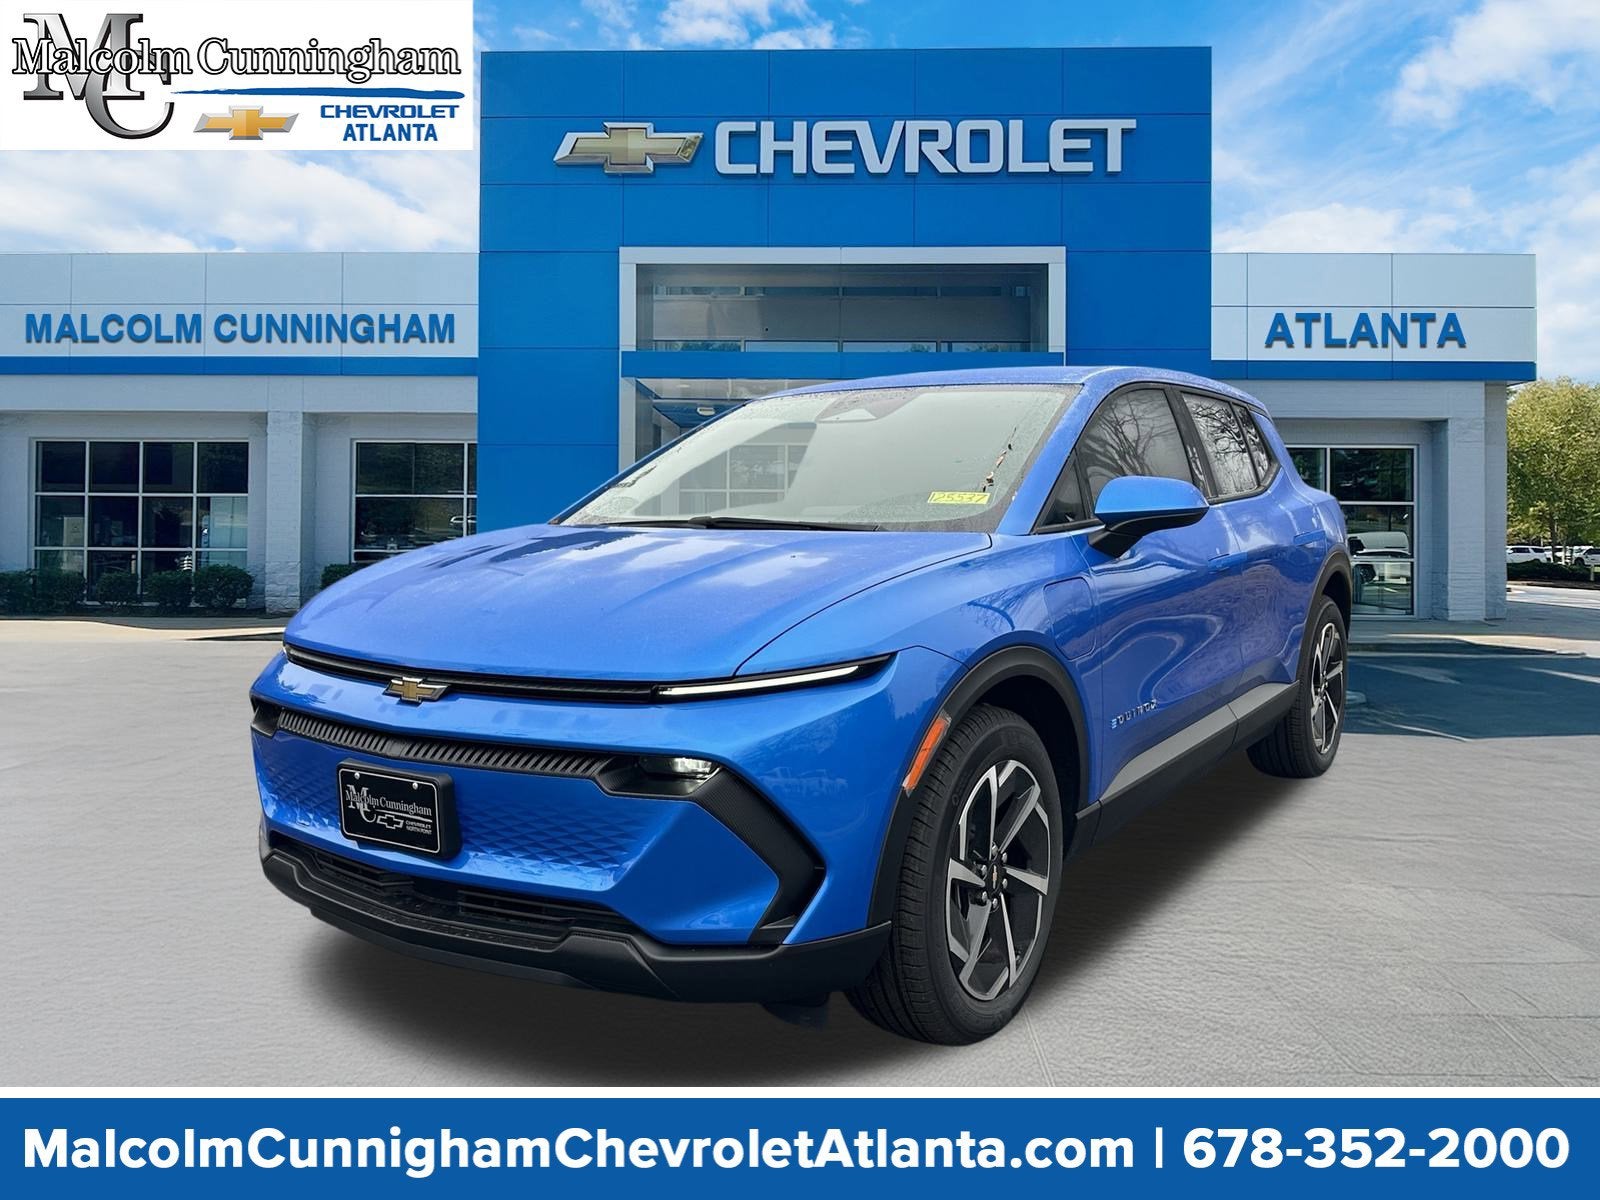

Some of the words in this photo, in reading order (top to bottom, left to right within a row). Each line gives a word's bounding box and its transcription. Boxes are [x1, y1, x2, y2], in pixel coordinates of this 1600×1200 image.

[715, 119, 1137, 174] CHEVROLET
[25, 313, 202, 343] MALCOLM
[213, 313, 456, 343] CUNNINGHAM
[1264, 312, 1467, 349] ATLANTA
[379, 796, 432, 817] Cunningham
